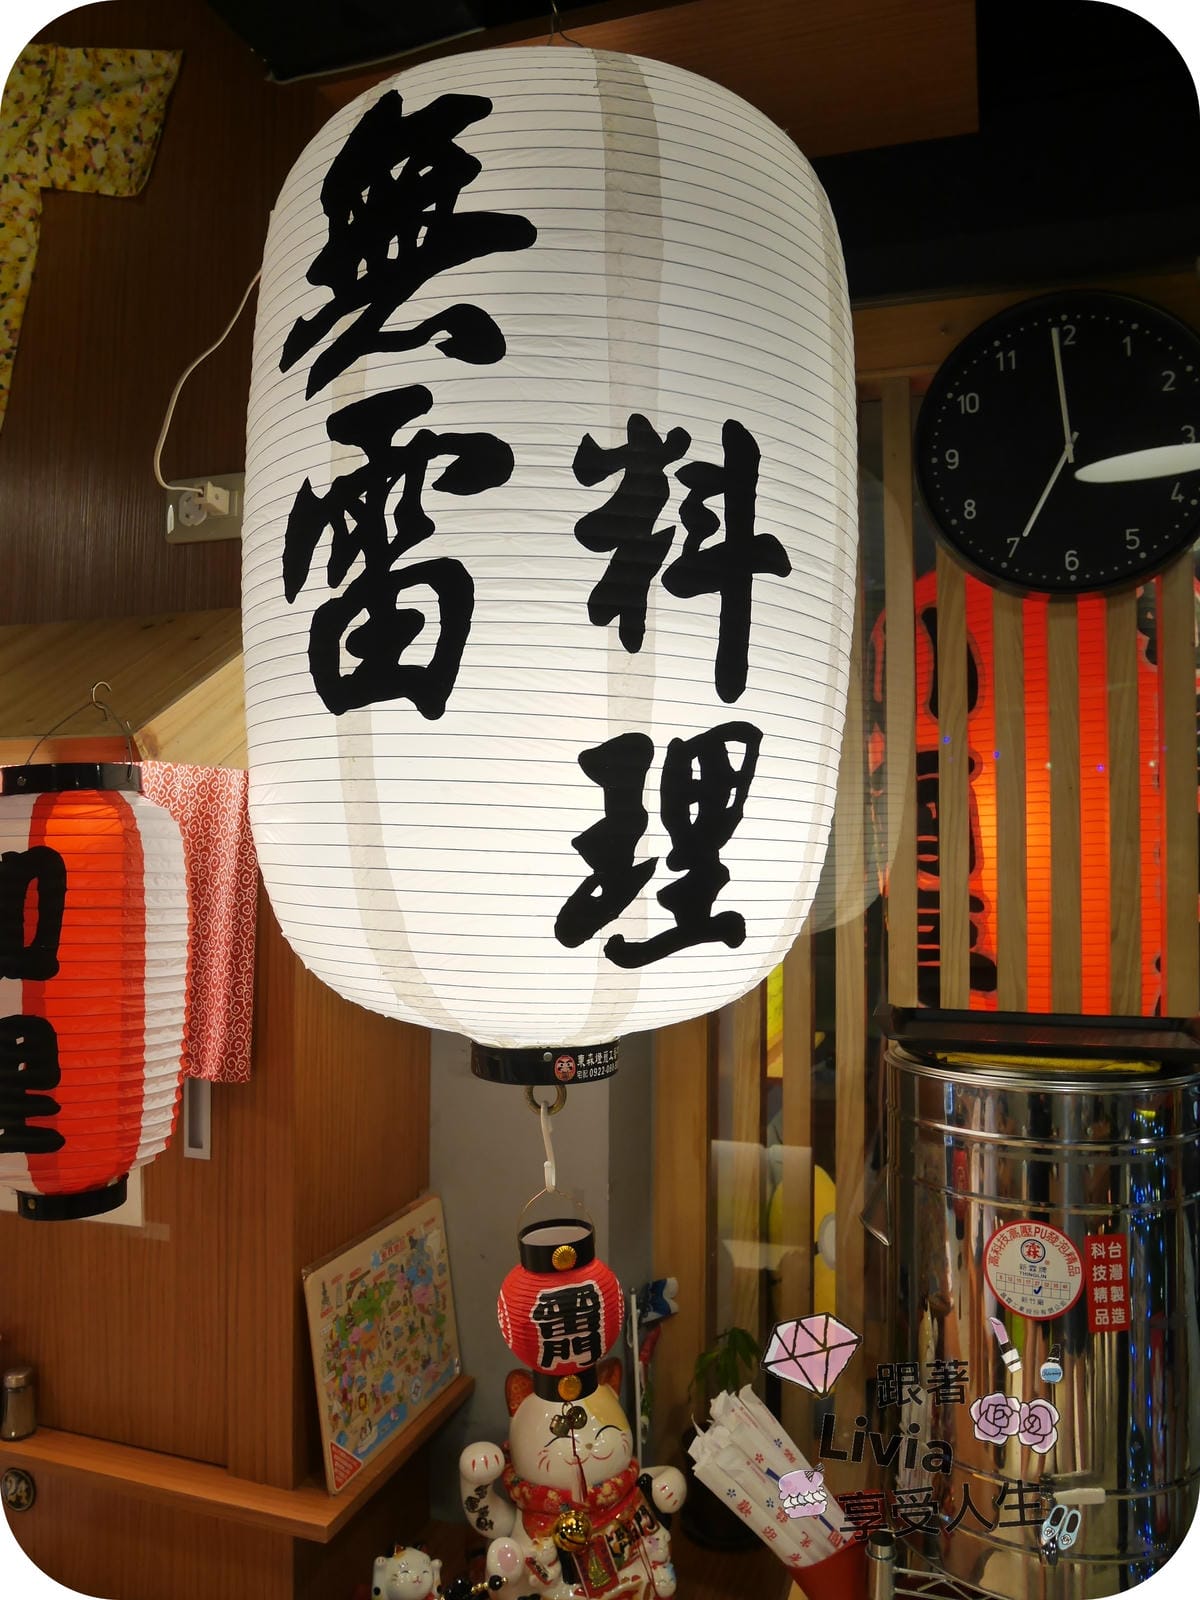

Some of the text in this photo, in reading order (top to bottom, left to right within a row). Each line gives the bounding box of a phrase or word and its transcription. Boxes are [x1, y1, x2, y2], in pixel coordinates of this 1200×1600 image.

[1122, 336, 1132, 357] 1
[996, 350, 1017, 371] 11
[1161, 370, 1176, 392] 2
[279, 88, 537, 720] 無雷
[957, 392, 980, 414] 10
[1180, 425, 1196, 445] 3
[945, 449, 960, 469] 9
[1171, 481, 1185, 502] 4
[963, 499, 977, 520] 8
[1006, 537, 1020, 558] 7
[1125, 528, 1140, 550] 5
[1064, 550, 1080, 571] 6
[555, 414, 792, 968] 料理
[1090, 1242, 1110, 1326] 科技精品
[1108, 1241, 1126, 1325] 台灣製造
